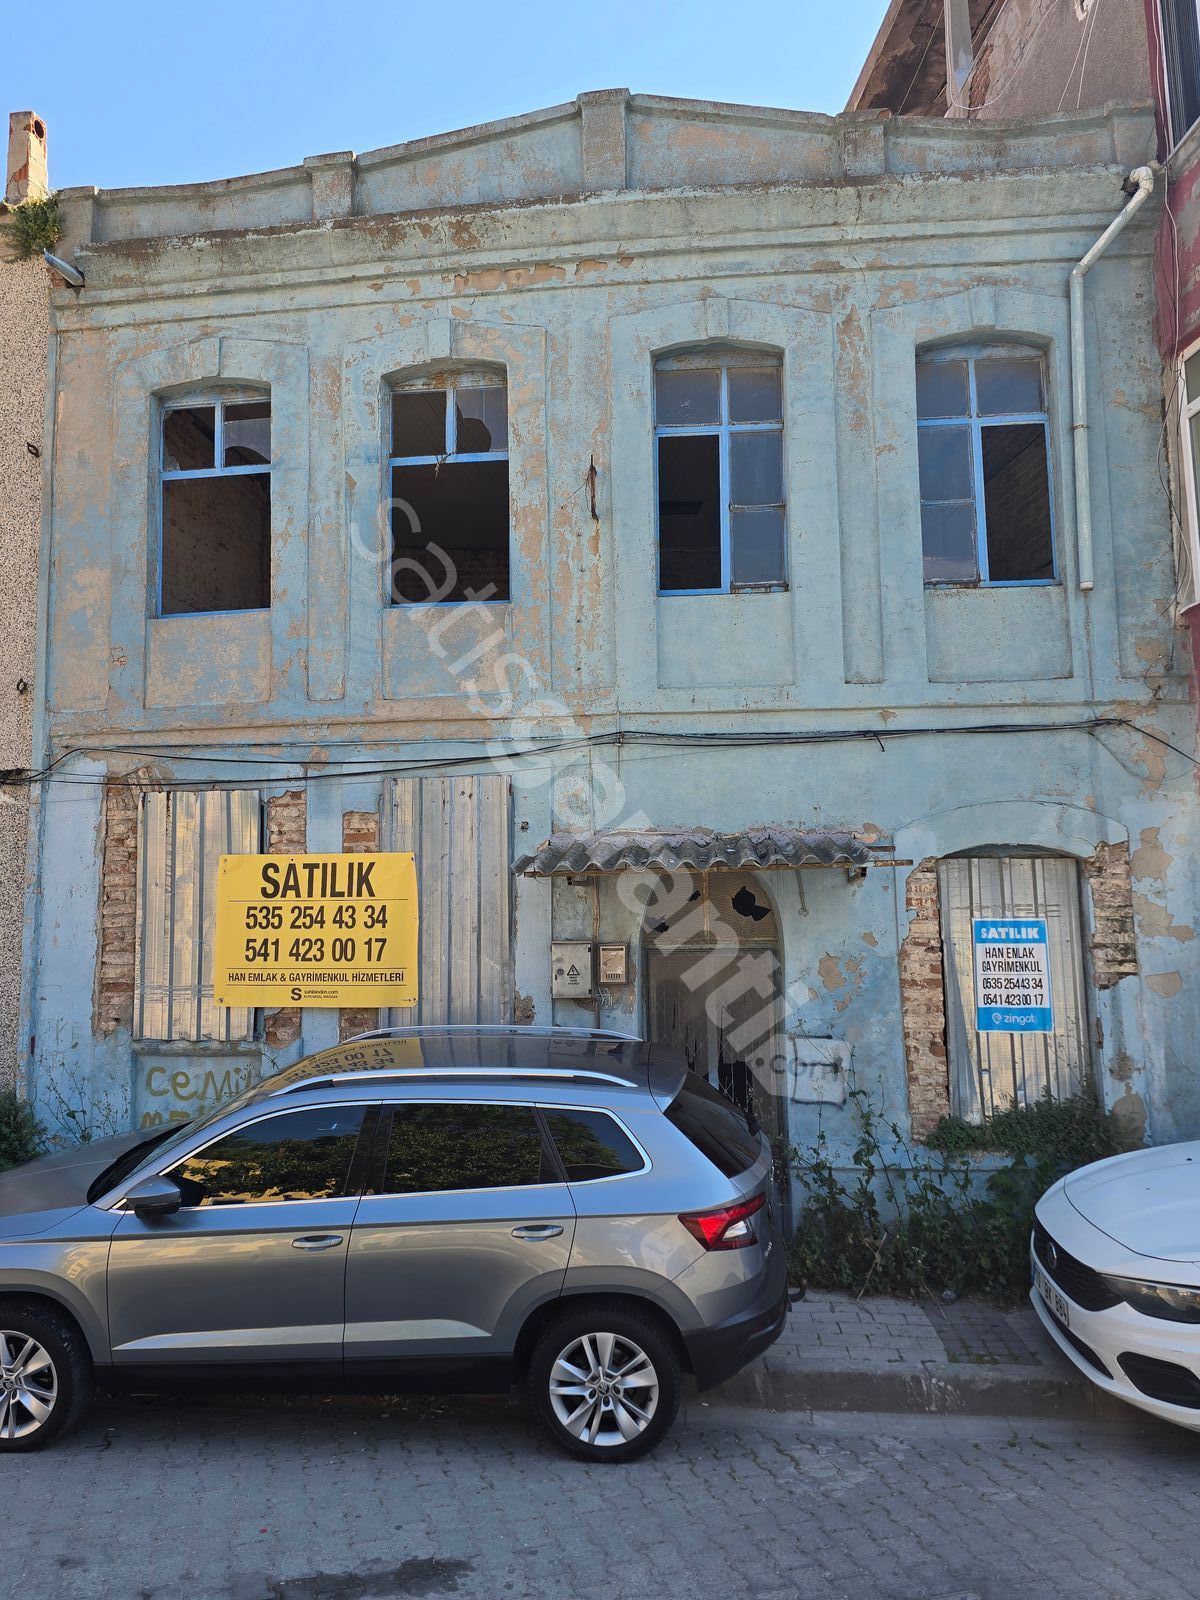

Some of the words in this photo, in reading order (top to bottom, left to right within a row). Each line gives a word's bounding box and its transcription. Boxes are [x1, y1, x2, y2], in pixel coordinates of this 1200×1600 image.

[260, 861, 376, 899] SATILIK
[245, 905, 283, 929] 535
[290, 905, 325, 929] 254
[332, 904, 356, 928] 43
[363, 904, 388, 928] 34
[981, 927, 1039, 939] SATILIK
[245, 938, 280, 962] 541
[288, 938, 325, 962] 423
[332, 938, 356, 962] 00
[364, 938, 388, 962] 17
[985, 947, 1004, 958] HAN
[1007, 947, 1035, 959] EMLAK
[982, 959, 1042, 972] GAYRİMENKUL
[228, 973, 246, 982] HAN
[248, 973, 278, 982] EMLAK
[280, 973, 286, 982] &
[289, 971, 349, 982] GAYRİMENKUL
[352, 970, 404, 982] HİZMETLERİ
[1031, 977, 1043, 989] 34
[1034, 994, 1044, 1005] 17
[1004, 1013, 1036, 1025] zingat
